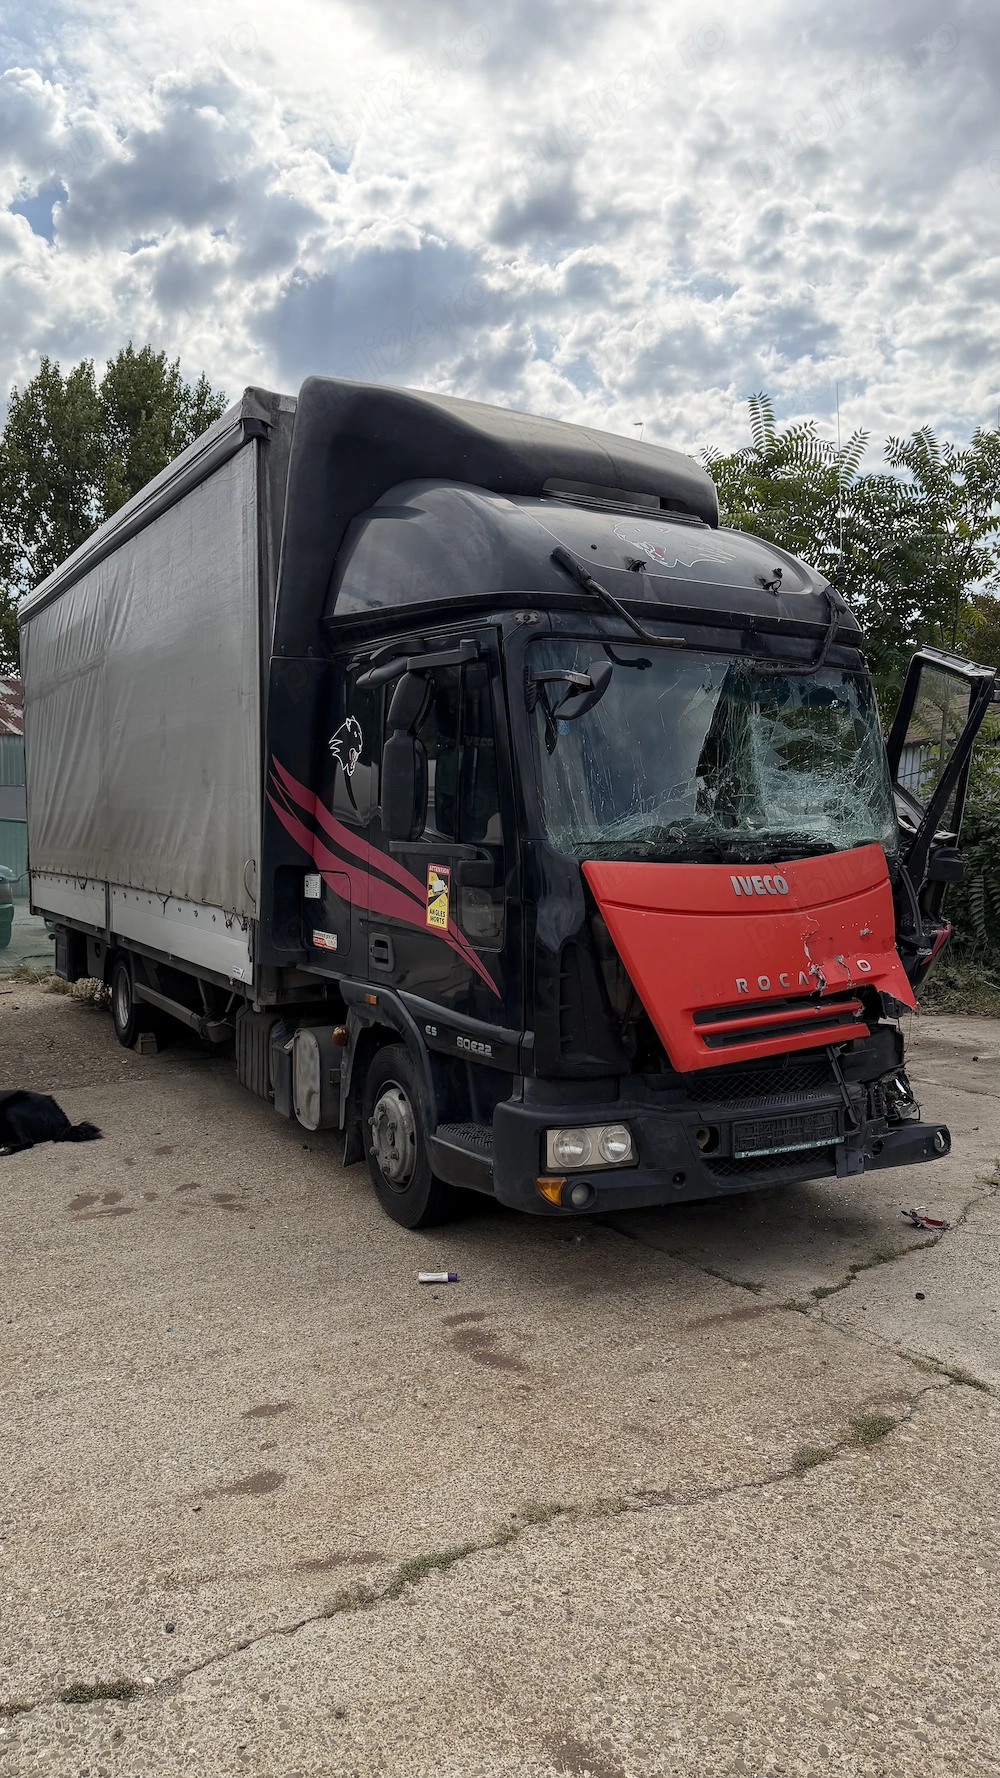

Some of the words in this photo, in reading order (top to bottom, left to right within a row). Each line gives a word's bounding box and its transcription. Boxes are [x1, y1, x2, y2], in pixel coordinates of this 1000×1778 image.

[463, 735, 494, 747] VECO
[429, 865, 450, 875] ATTENTION
[730, 875, 789, 896] IVECO
[429, 908, 446, 918] ANGLES
